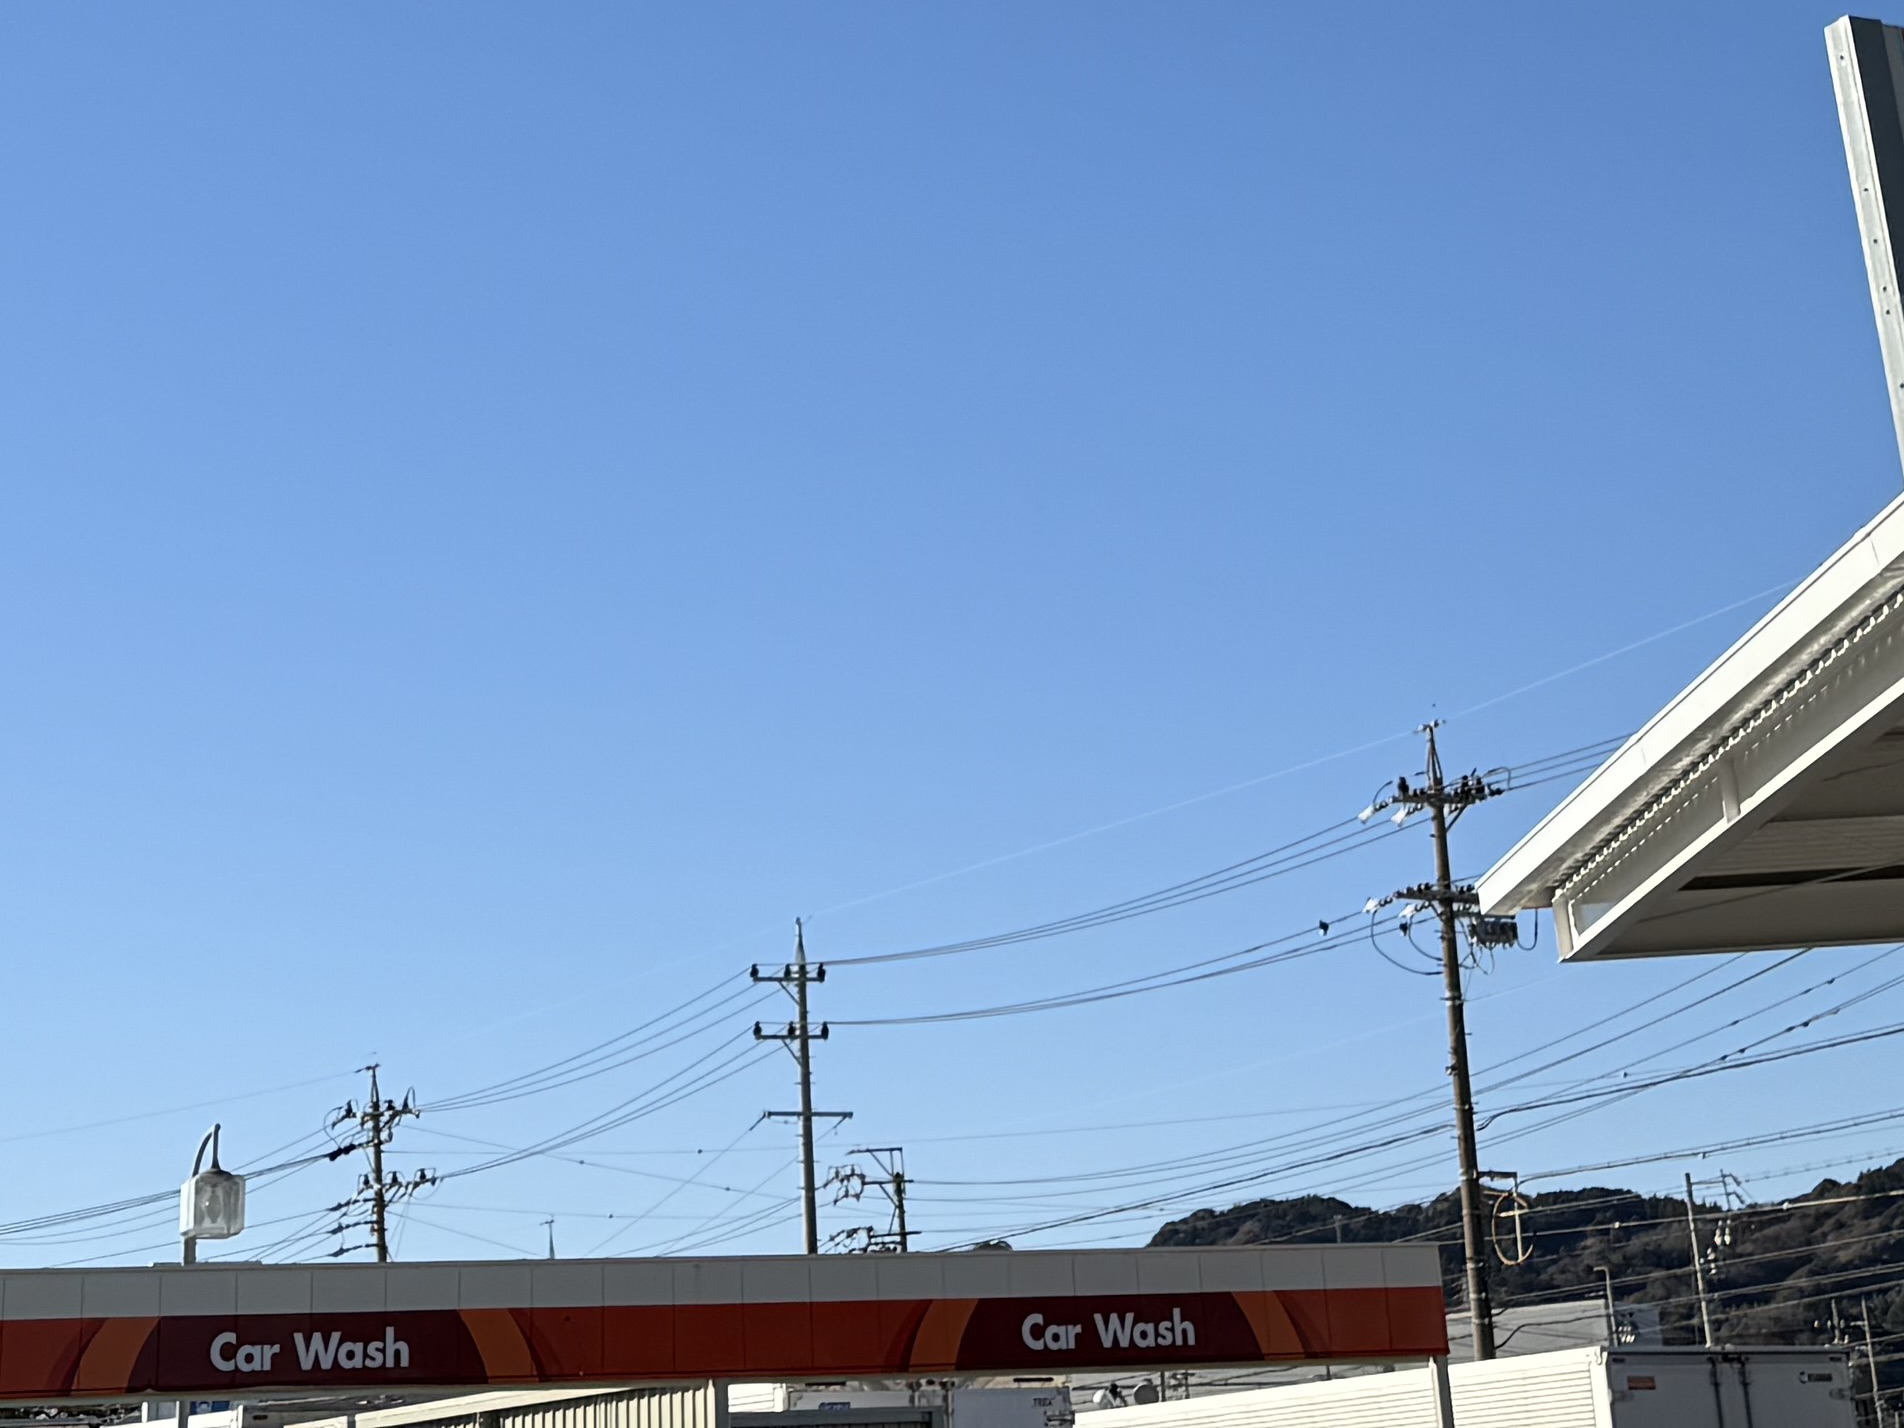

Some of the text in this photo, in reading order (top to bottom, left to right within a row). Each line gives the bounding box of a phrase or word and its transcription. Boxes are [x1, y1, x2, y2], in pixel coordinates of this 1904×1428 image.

[210, 1326, 410, 1372] Car Wash
[1022, 1307, 1196, 1351] Car Wash
